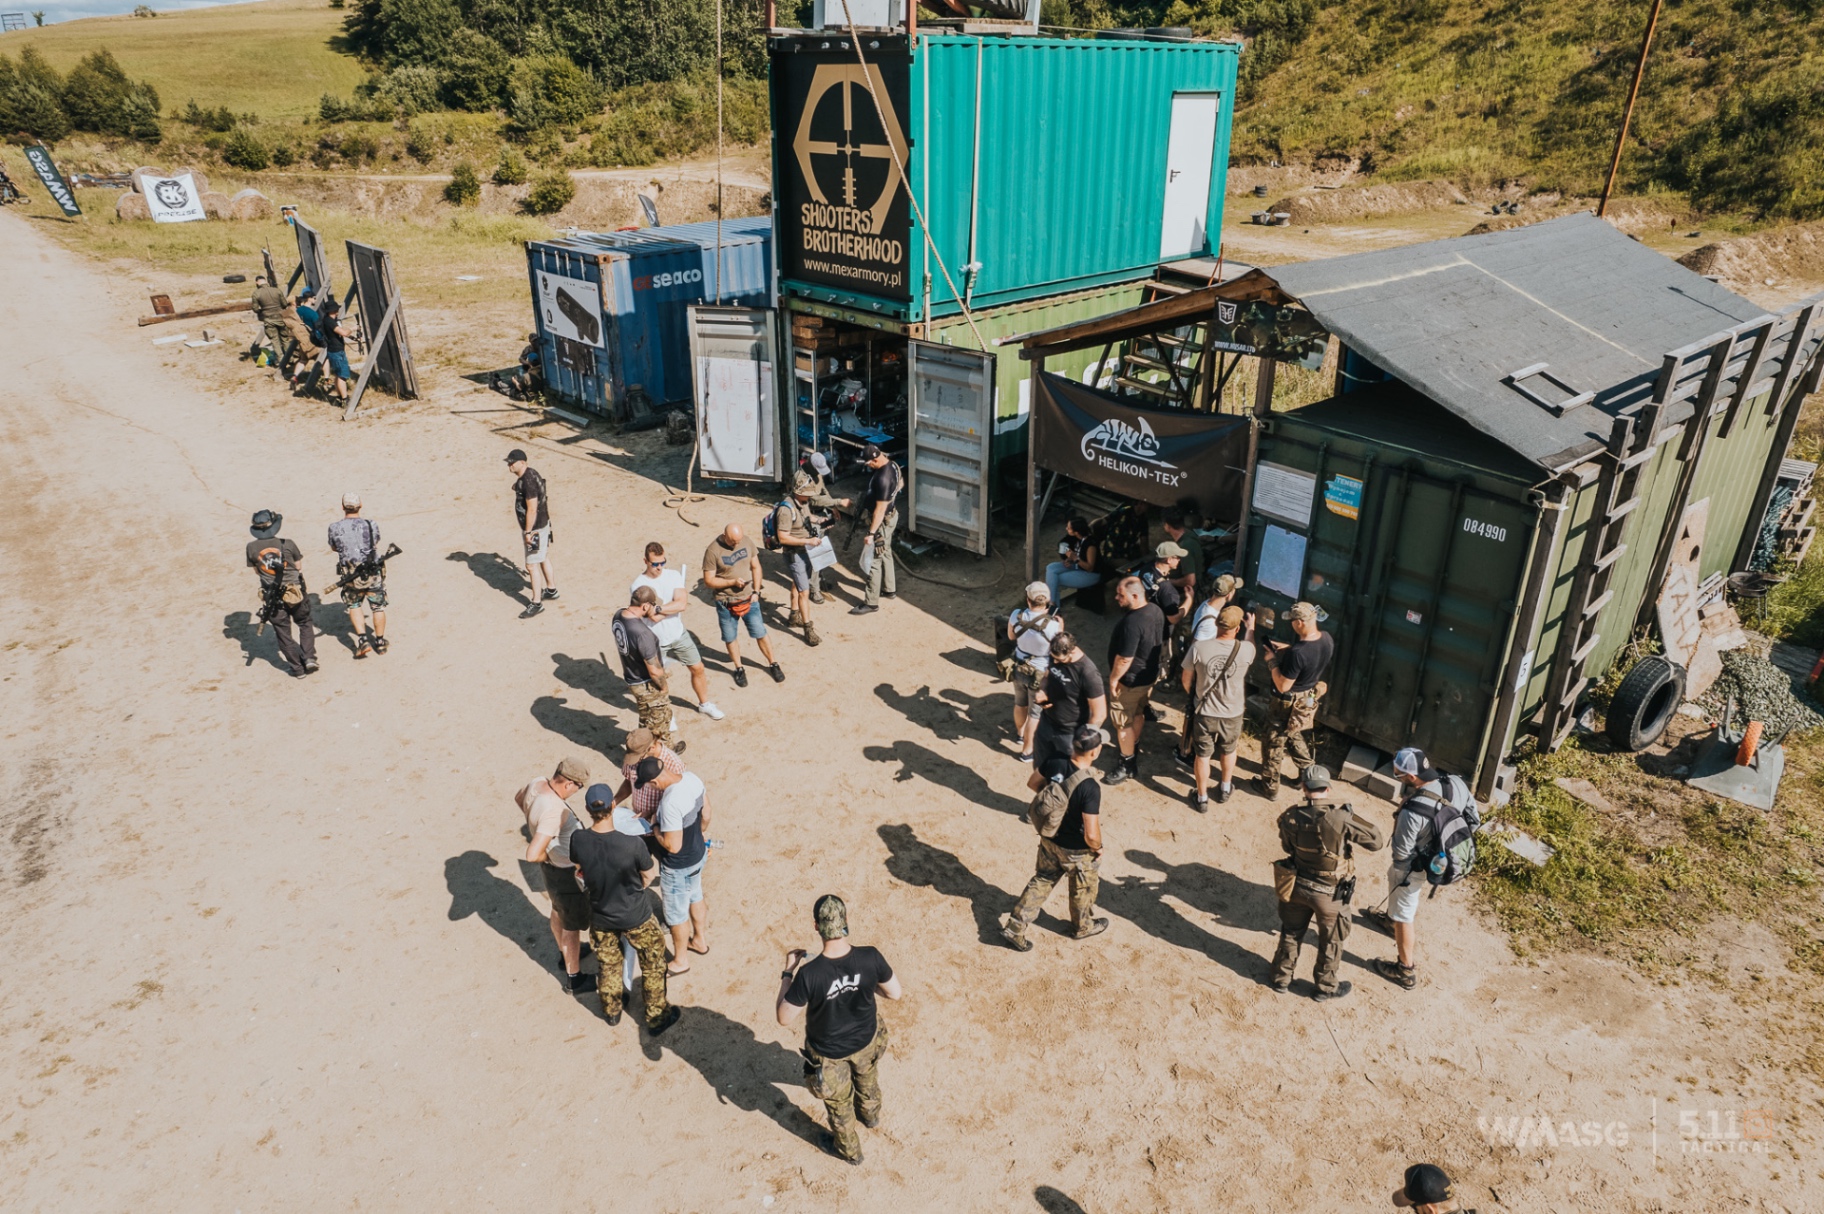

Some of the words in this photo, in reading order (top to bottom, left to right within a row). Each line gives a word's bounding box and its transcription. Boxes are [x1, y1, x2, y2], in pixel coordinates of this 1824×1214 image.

[801, 203, 871, 235] SHOOTERS
[803, 228, 903, 265] BROTHERHOOD
[803, 259, 902, 288] www.mexarmory.pl
[1463, 517, 1507, 542] 084990
